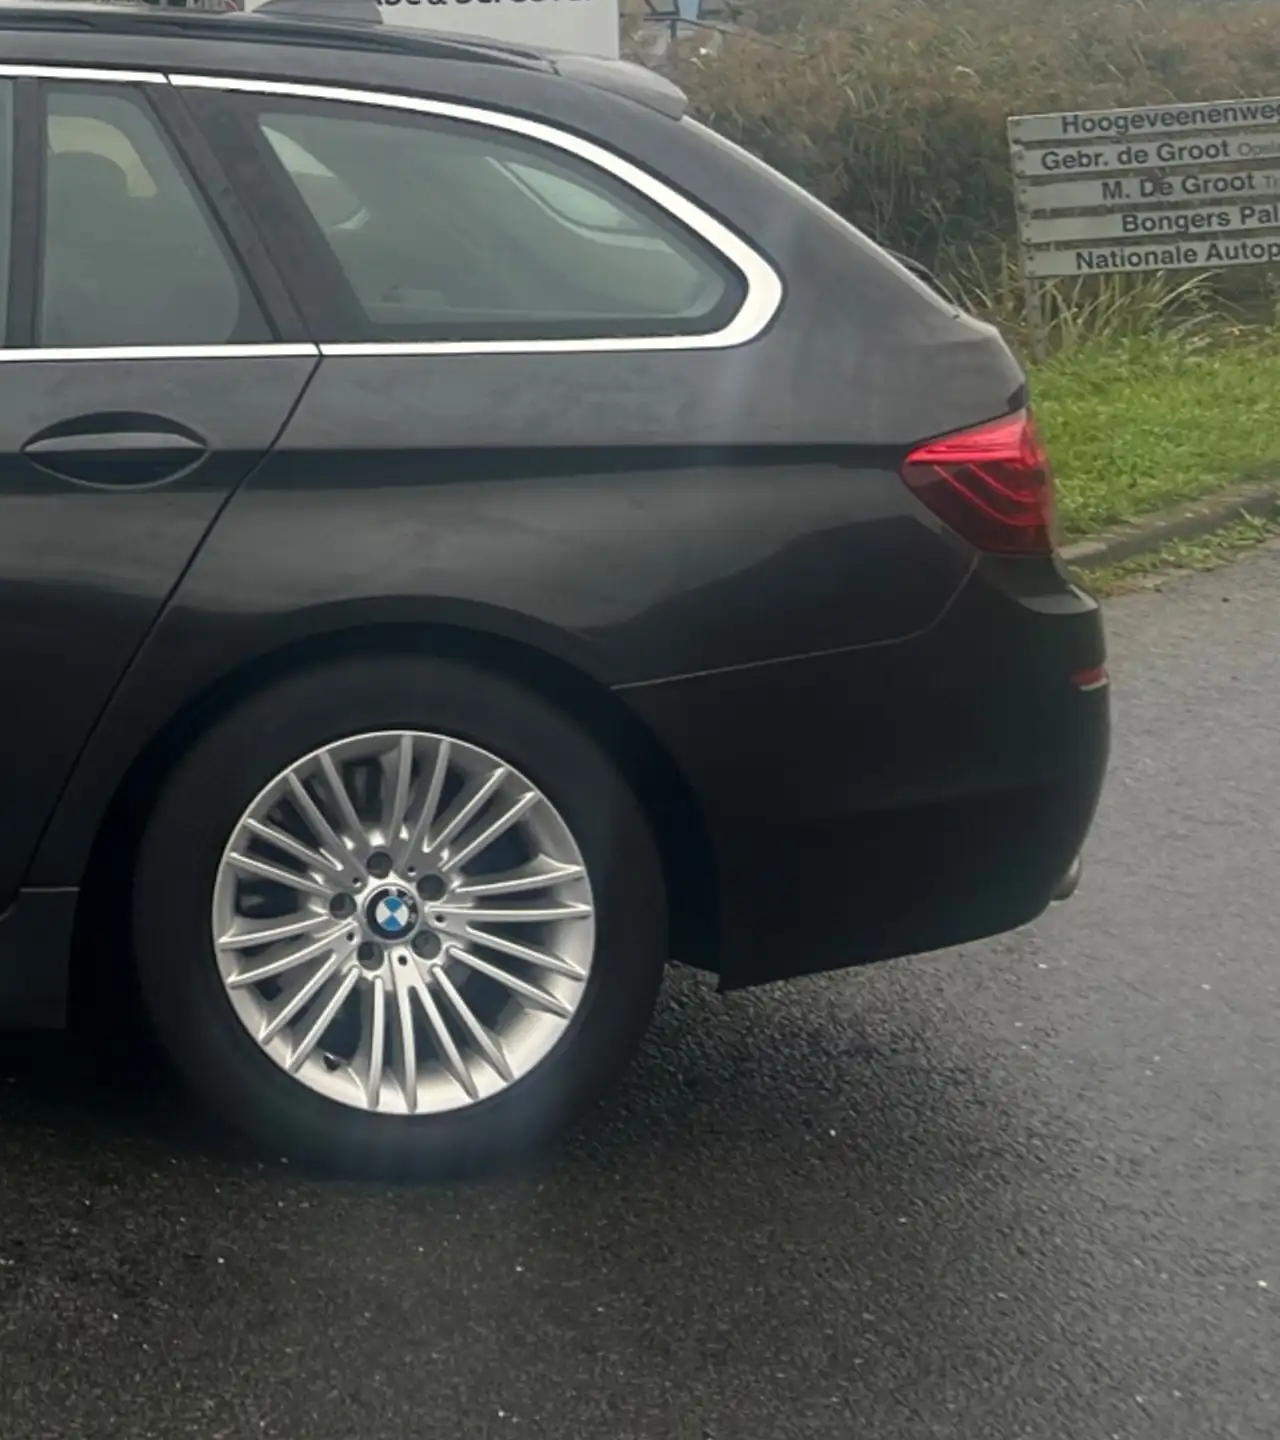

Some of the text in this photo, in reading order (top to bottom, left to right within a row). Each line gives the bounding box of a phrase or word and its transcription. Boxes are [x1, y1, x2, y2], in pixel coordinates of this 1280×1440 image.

[1041, 149, 1110, 171] Gebr.
[1117, 146, 1150, 166] de
[1156, 139, 1230, 163] Groot
[1101, 180, 1131, 201] M.
[1139, 178, 1174, 198] De
[1181, 172, 1256, 195] Groot
[1121, 210, 1231, 233] Bongers
[1075, 244, 1198, 271] Nationale
